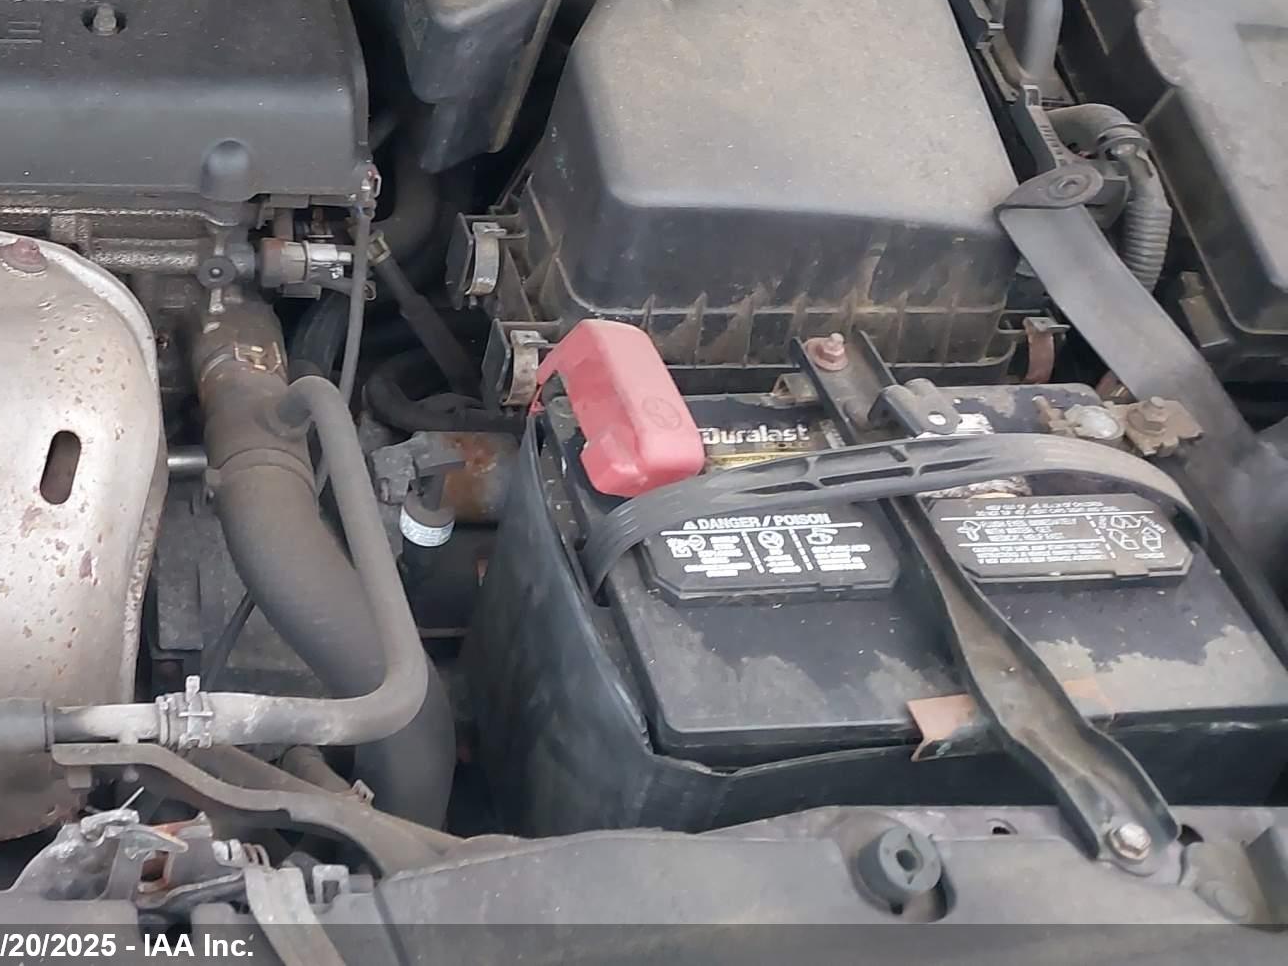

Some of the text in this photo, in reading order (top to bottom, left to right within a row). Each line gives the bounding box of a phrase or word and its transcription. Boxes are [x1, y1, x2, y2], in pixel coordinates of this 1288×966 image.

[699, 423, 811, 446] Duralast
[697, 515, 760, 530] DANGER
[774, 513, 832, 527] POISON
